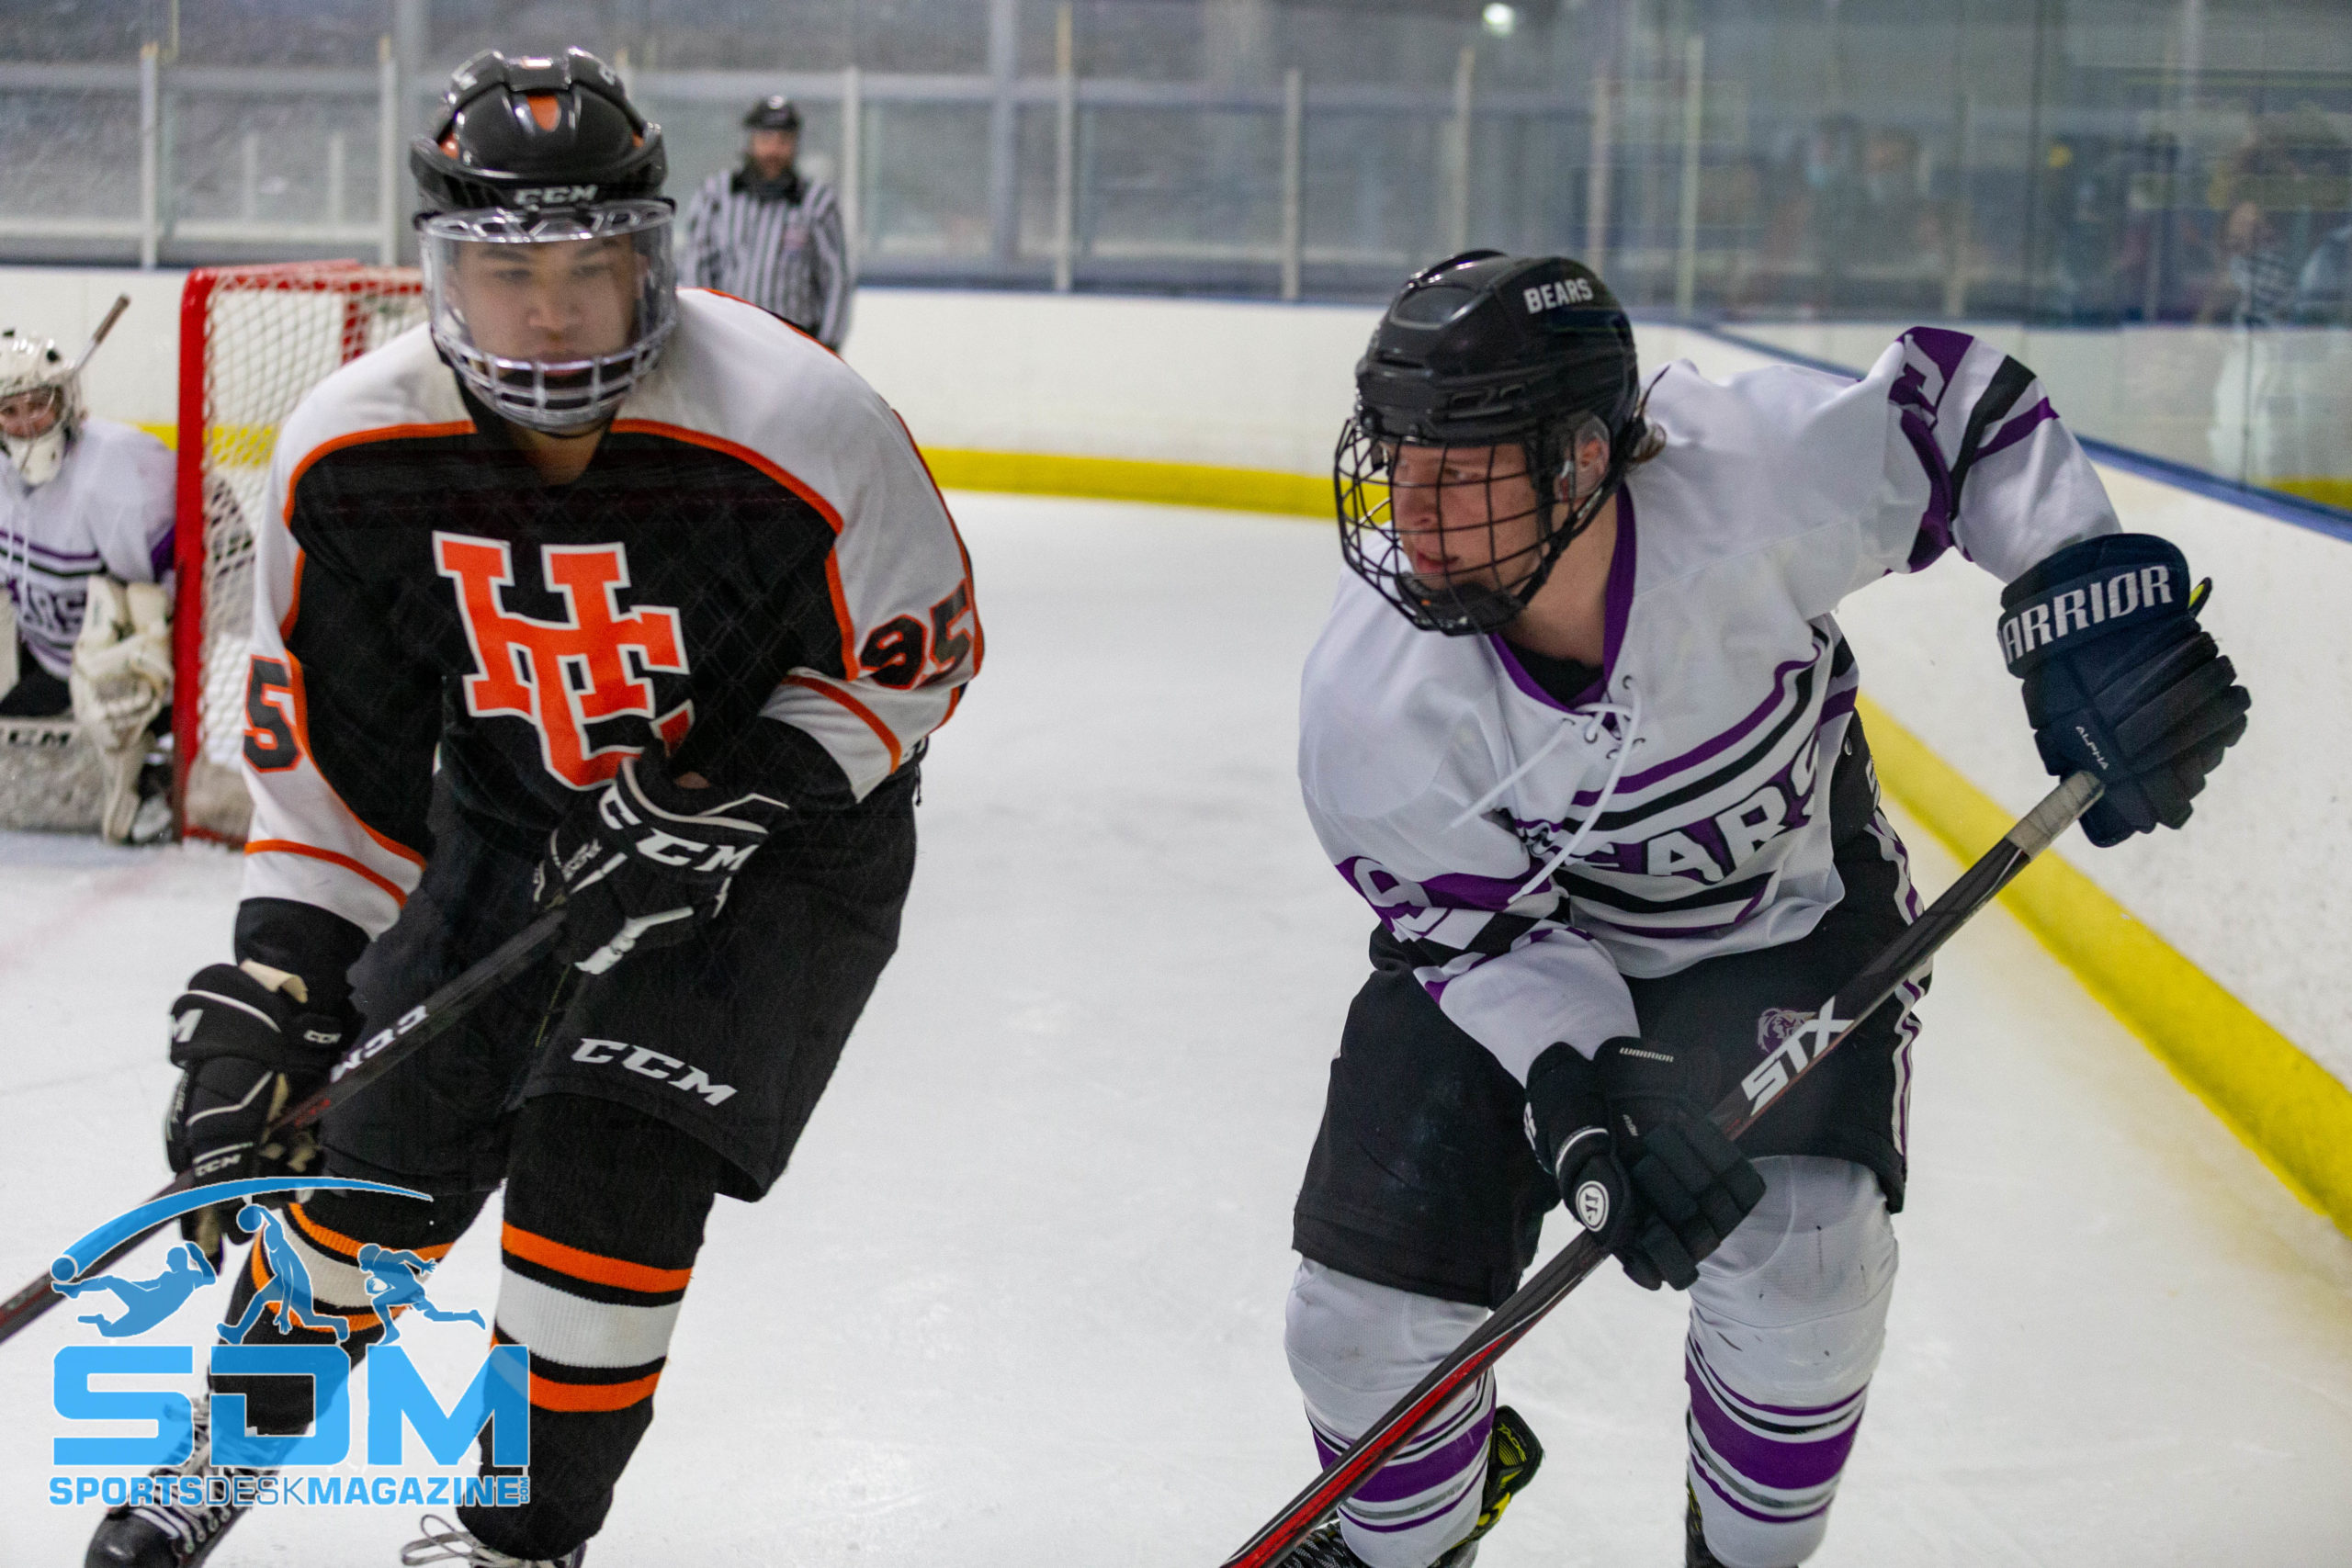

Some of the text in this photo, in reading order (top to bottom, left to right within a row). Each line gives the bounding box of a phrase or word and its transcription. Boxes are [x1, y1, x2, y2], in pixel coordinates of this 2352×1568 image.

[514, 185, 598, 209] CCM
[1523, 277, 1594, 314] BEARS
[858, 578, 974, 691] 95
[1999, 565, 2173, 664] ARRIOR
[243, 655, 305, 772] 5
[2075, 726, 2109, 770] ALPHA
[599, 784, 759, 872] CCM
[330, 1006, 428, 1082] CCM
[571, 1038, 738, 1106] CCM
[1620, 1046, 1675, 1063] WARRIOR
[1740, 995, 1854, 1116] STX
[195, 1154, 241, 1177] CCM
